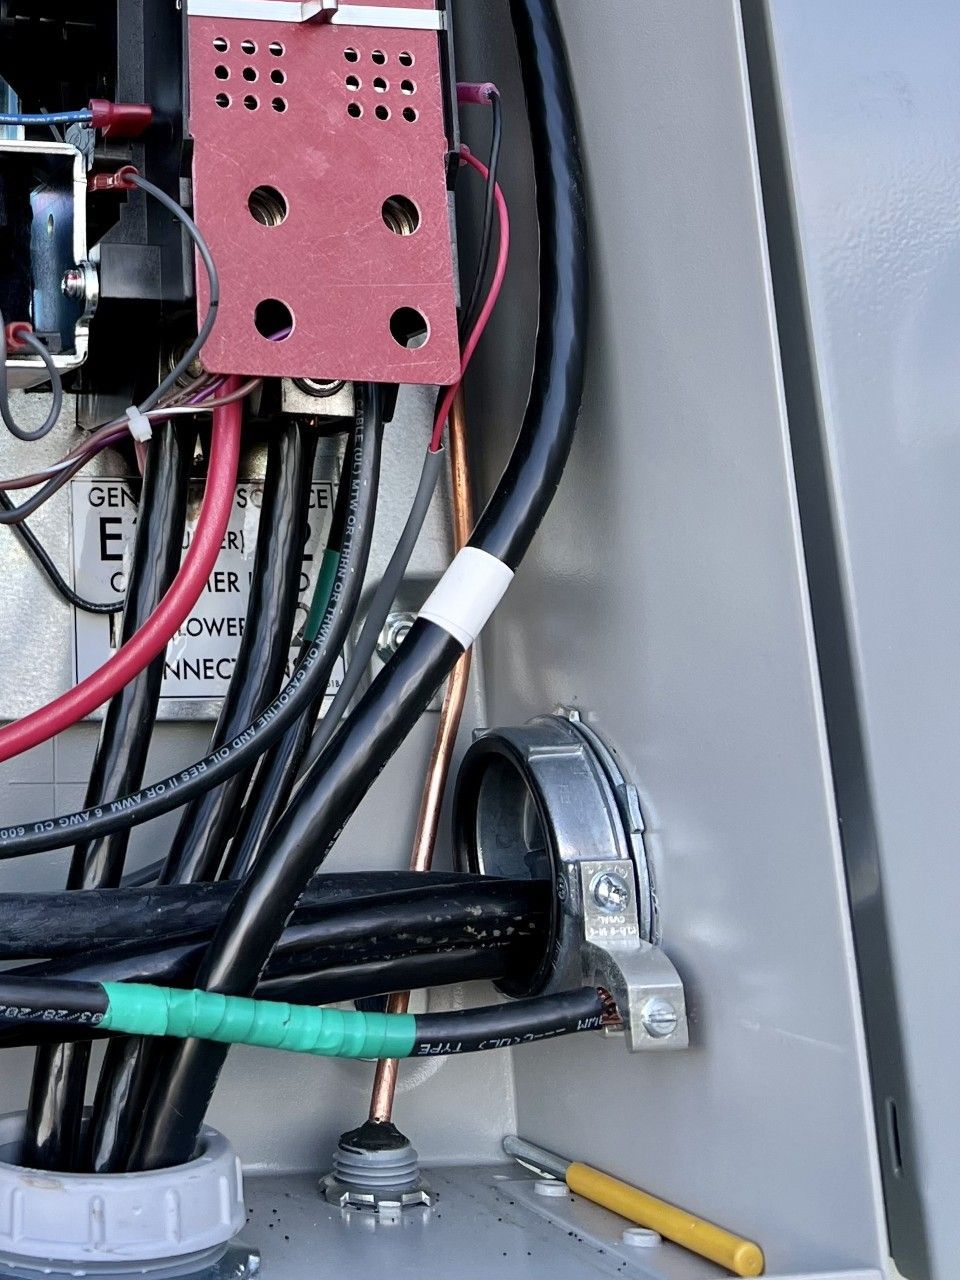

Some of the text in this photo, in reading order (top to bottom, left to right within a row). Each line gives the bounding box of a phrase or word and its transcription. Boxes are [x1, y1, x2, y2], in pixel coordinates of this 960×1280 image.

[354, 398, 364, 447] CABLE
[348, 479, 361, 512] MTW
[344, 515, 357, 535] OR
[337, 538, 355, 574] THHN
[330, 581, 343, 604] OR
[314, 606, 336, 645] THWN
[304, 648, 319, 668] OR
[254, 667, 308, 730] GASOLINE
[232, 726, 256, 750] AND
[209, 747, 230, 765] OIL
[180, 760, 208, 782] RES
[147, 783, 166, 798] OR
[110, 795, 142, 812] AWM
[33, 822, 54, 833] CU
[59, 812, 90, 827] AWG
[417, 1042, 462, 1056] TYPE
